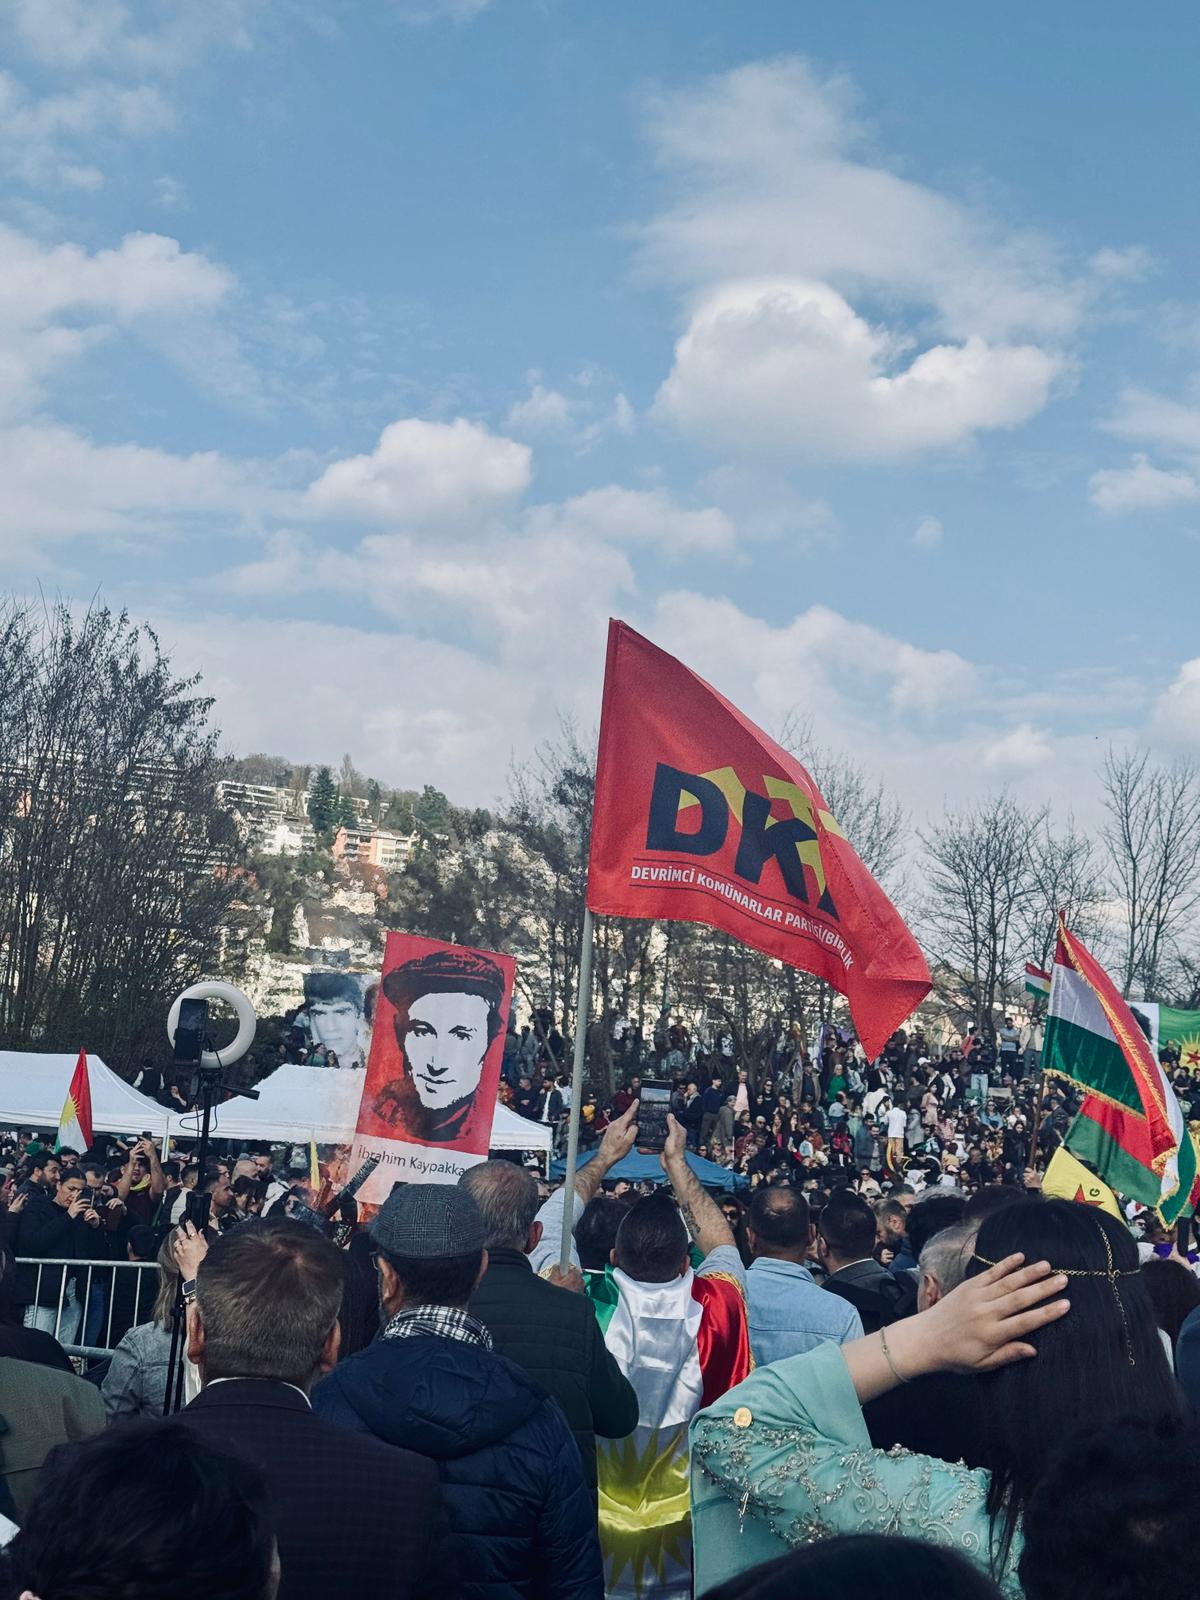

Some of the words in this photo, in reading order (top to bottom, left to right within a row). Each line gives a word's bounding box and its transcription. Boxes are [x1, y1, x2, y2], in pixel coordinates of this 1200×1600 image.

[646, 762, 839, 922] DK
[631, 866, 696, 883] DEVRİMCİ
[696, 873, 783, 923] KOMÜNARLAR
[409, 1156, 468, 1176] Kaypakka
